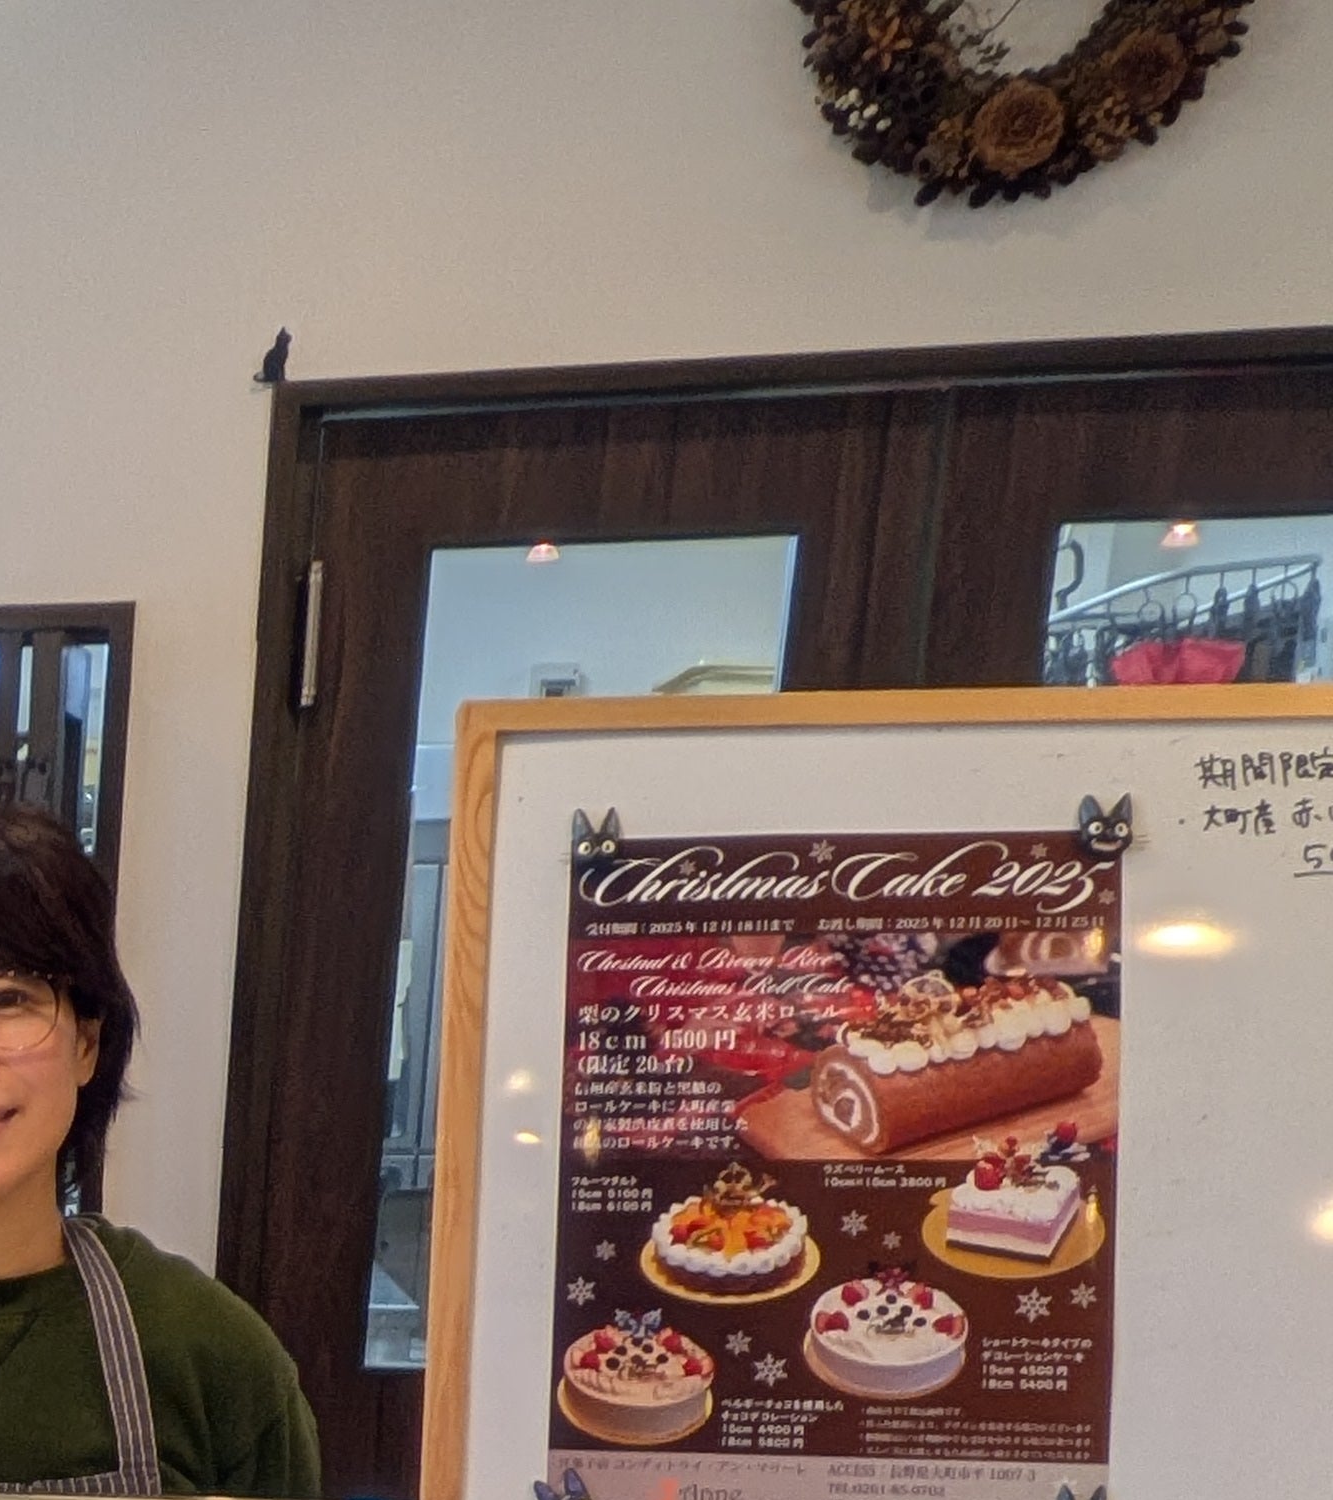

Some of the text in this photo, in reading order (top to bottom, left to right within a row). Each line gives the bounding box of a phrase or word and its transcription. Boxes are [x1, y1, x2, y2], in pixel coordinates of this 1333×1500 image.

[1292, 797, 1333, 829] 赤
[1303, 844, 1333, 870] 5
[579, 840, 1116, 915] Christmas Cake 2025
[577, 950, 668, 972] Chestnut
[696, 947, 775, 971] Brown
[780, 946, 835, 969] Rice
[630, 973, 854, 997] Christmas Roll Cake
